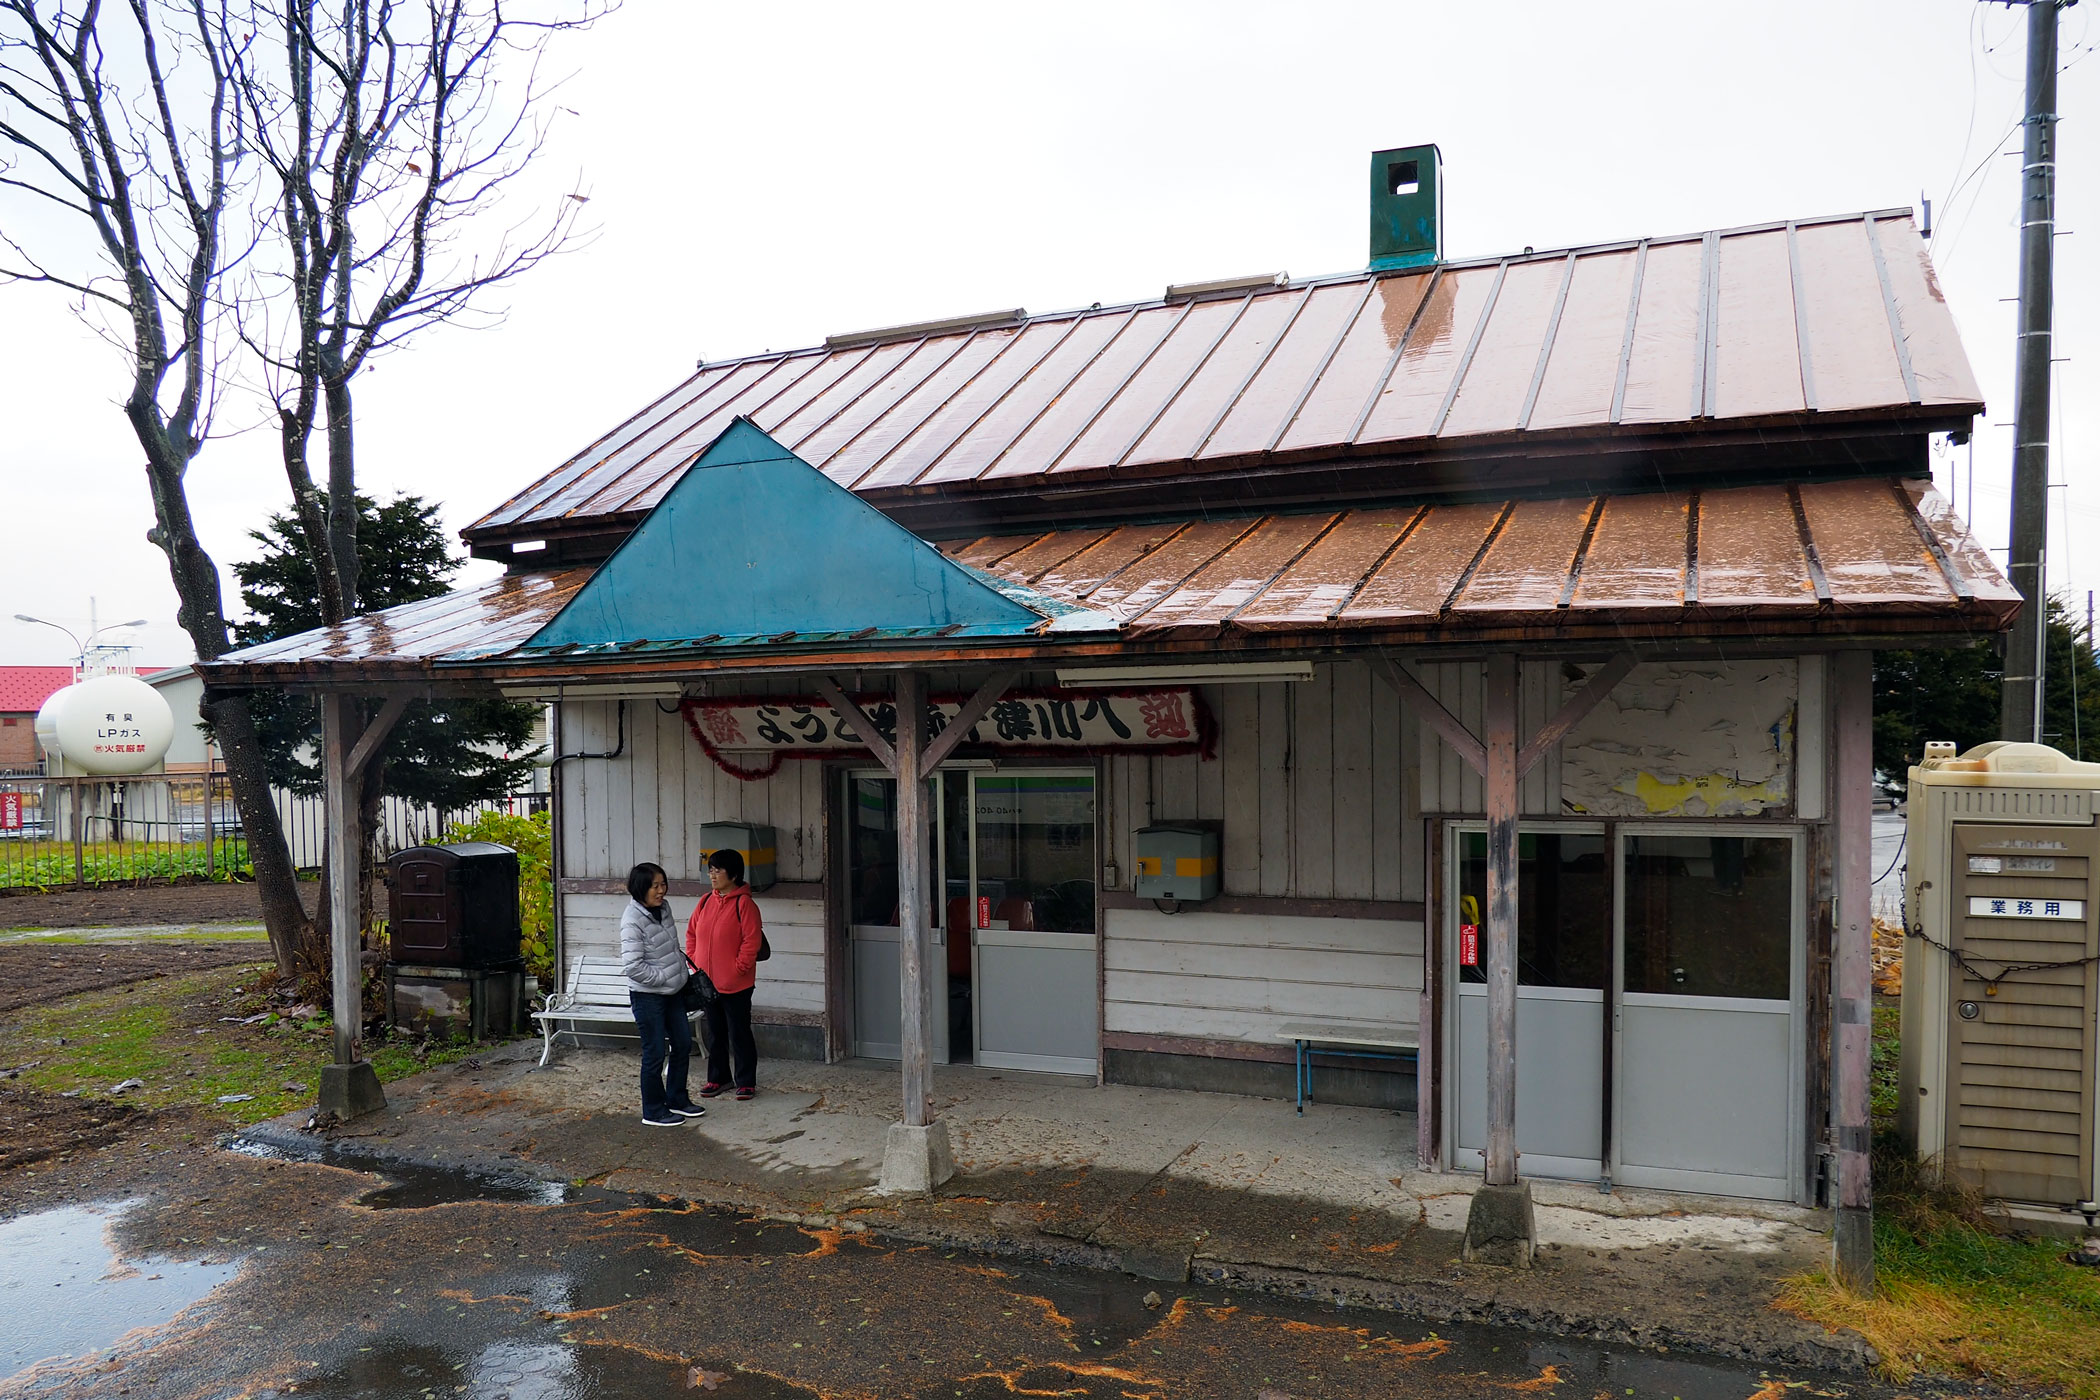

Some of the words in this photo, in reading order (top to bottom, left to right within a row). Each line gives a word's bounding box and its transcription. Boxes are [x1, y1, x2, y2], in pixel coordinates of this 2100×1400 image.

[105, 713, 133, 722] 有臭
[98, 728, 141, 738] LPガス
[104, 744, 146, 753] 火気厳禁
[1990, 900, 2060, 916] 業務用
